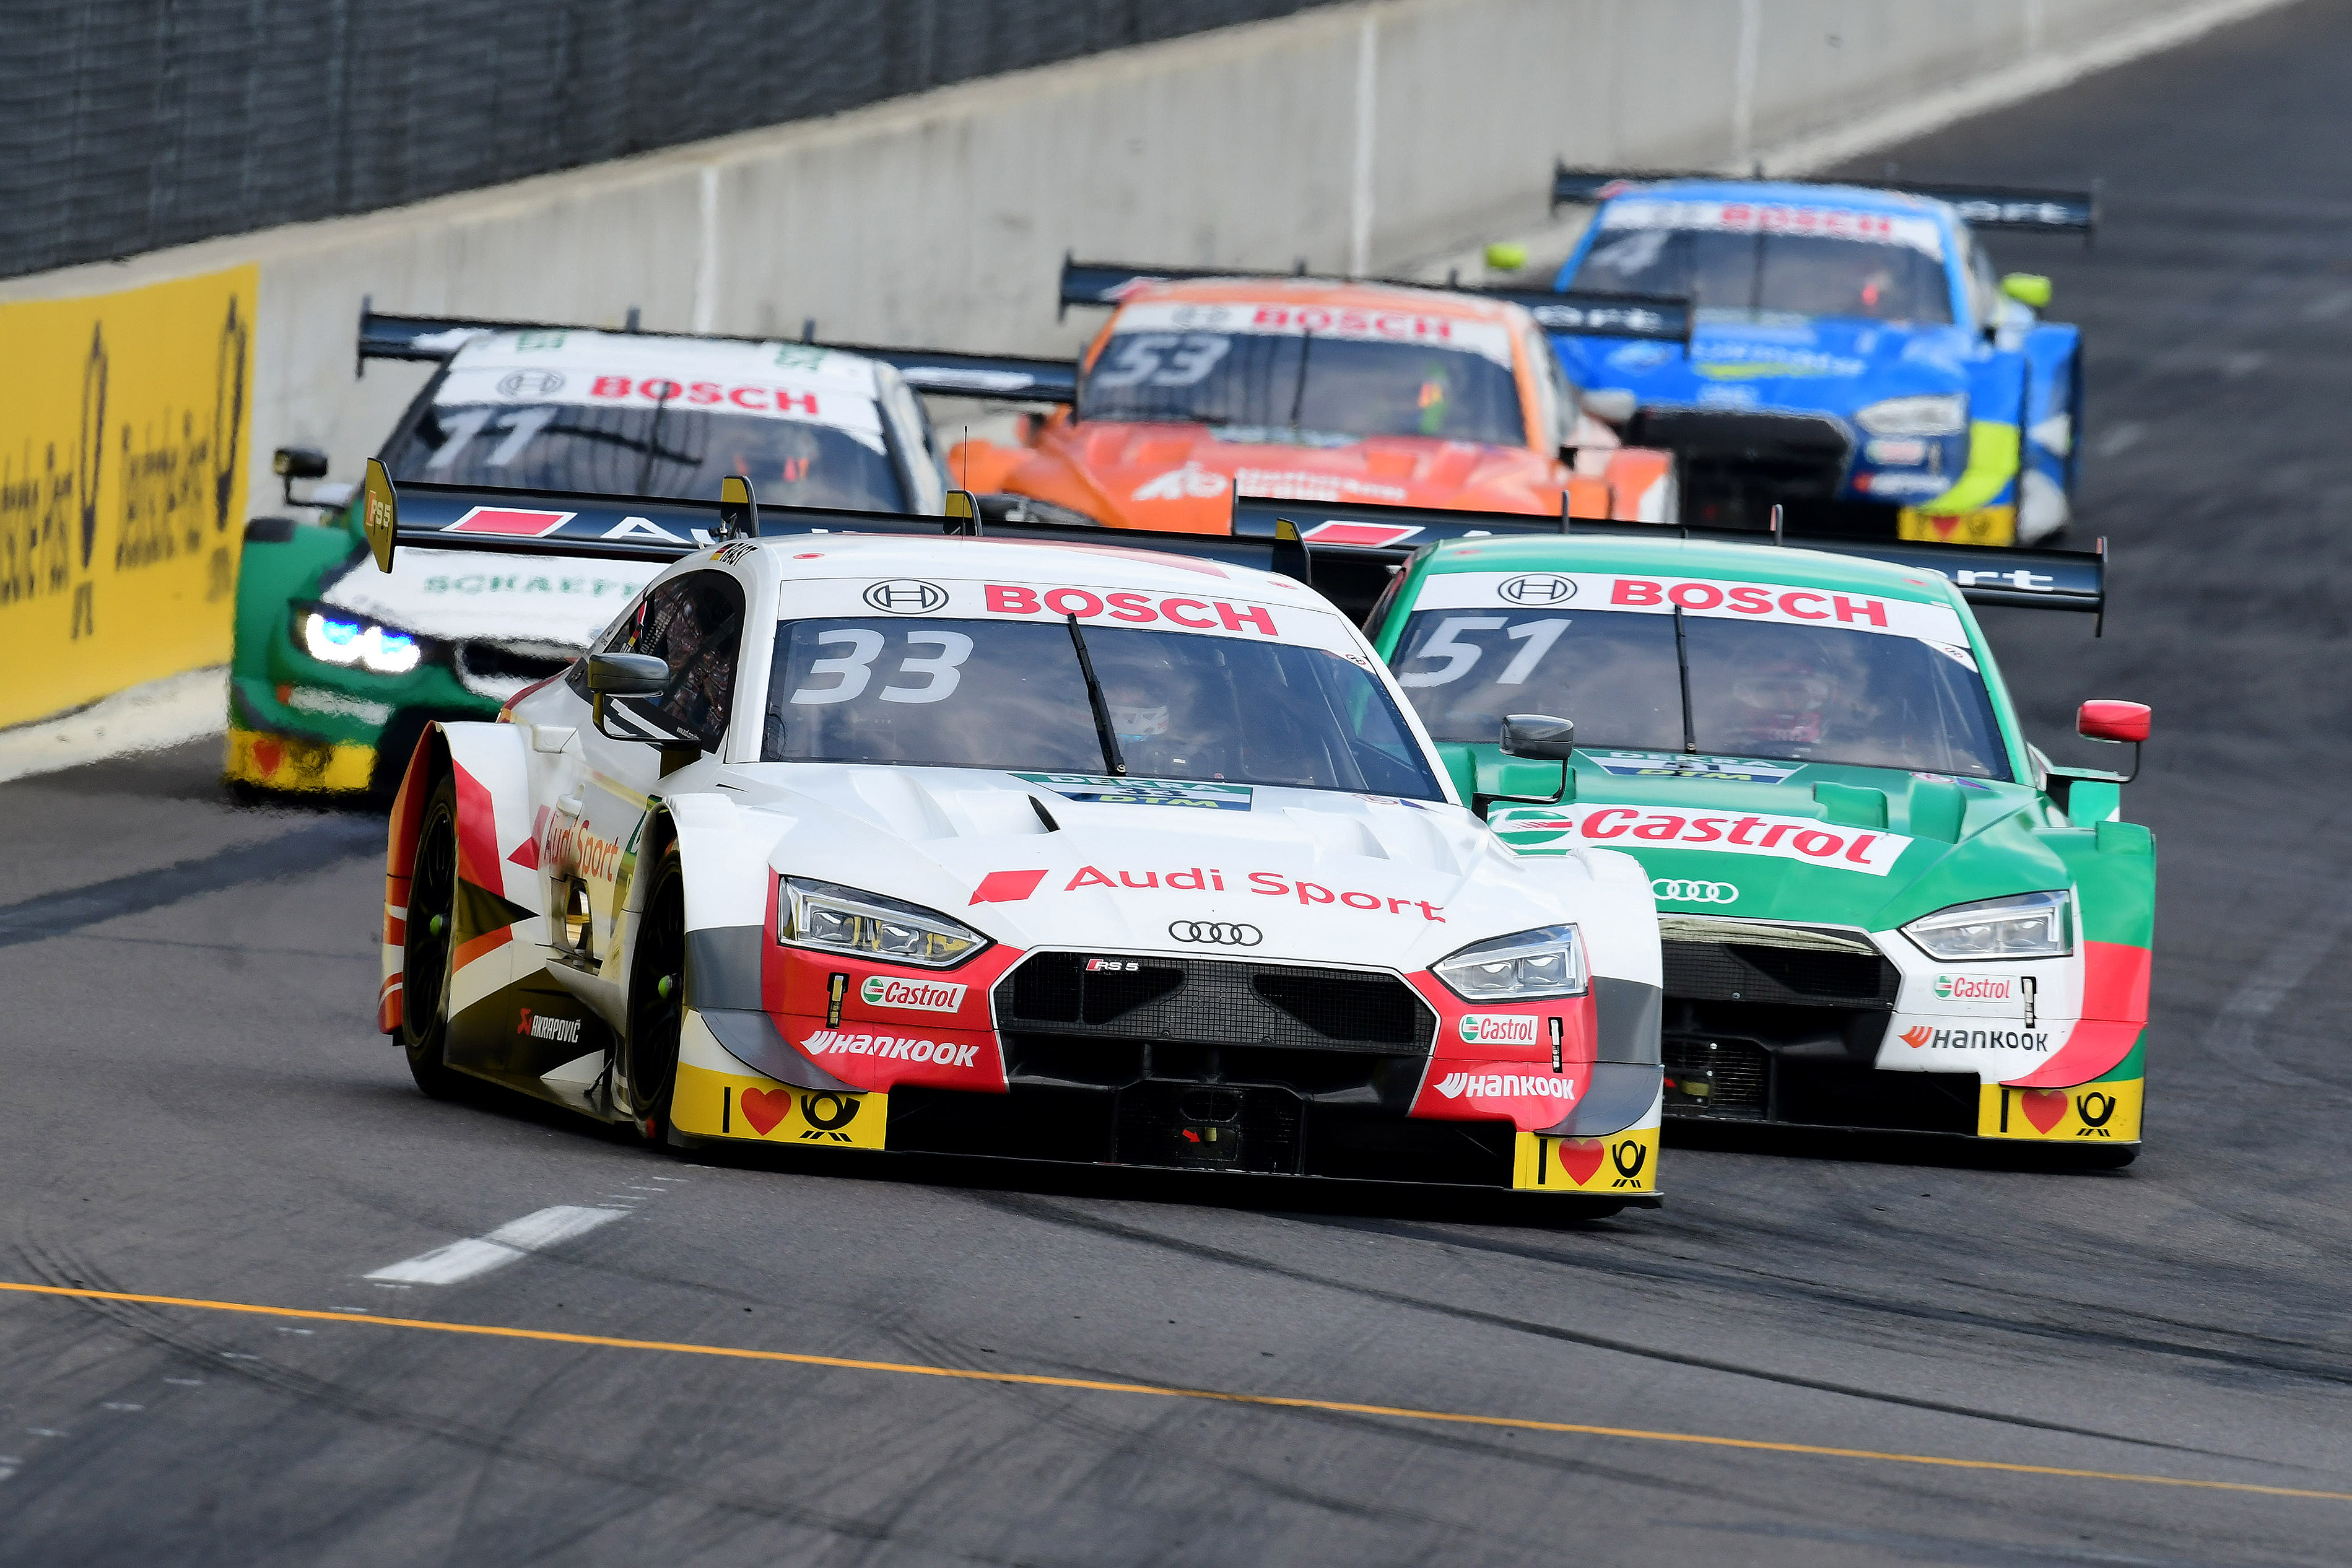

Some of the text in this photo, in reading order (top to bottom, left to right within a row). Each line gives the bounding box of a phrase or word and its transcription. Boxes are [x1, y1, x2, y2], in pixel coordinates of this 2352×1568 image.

[1253, 306, 1451, 343] BOSCH
[1095, 335, 1232, 388] 53
[590, 376, 820, 414] BOSCH
[429, 407, 555, 468] 11
[984, 584, 1279, 637] BOSCH
[1610, 578, 1888, 627] BOSCH
[790, 629, 974, 704] 33
[1399, 616, 1572, 687] 51
[1610, 752, 1778, 768] DEKRA
[1047, 775, 1229, 792] DEKRA
[1099, 795, 1219, 808] DTM
[576, 819, 619, 882] Sport
[1581, 808, 1879, 865] Castrol
[1063, 865, 1446, 923] Audi Sport
[1125, 962, 1139, 971] 5
[1954, 977, 2010, 999] Castrol
[886, 981, 958, 1008] Castrol
[1481, 1018, 1533, 1040] Castrol
[723, 1087, 731, 1133] I
[2000, 1090, 2009, 1133] I
[1538, 1139, 1547, 1184] I
